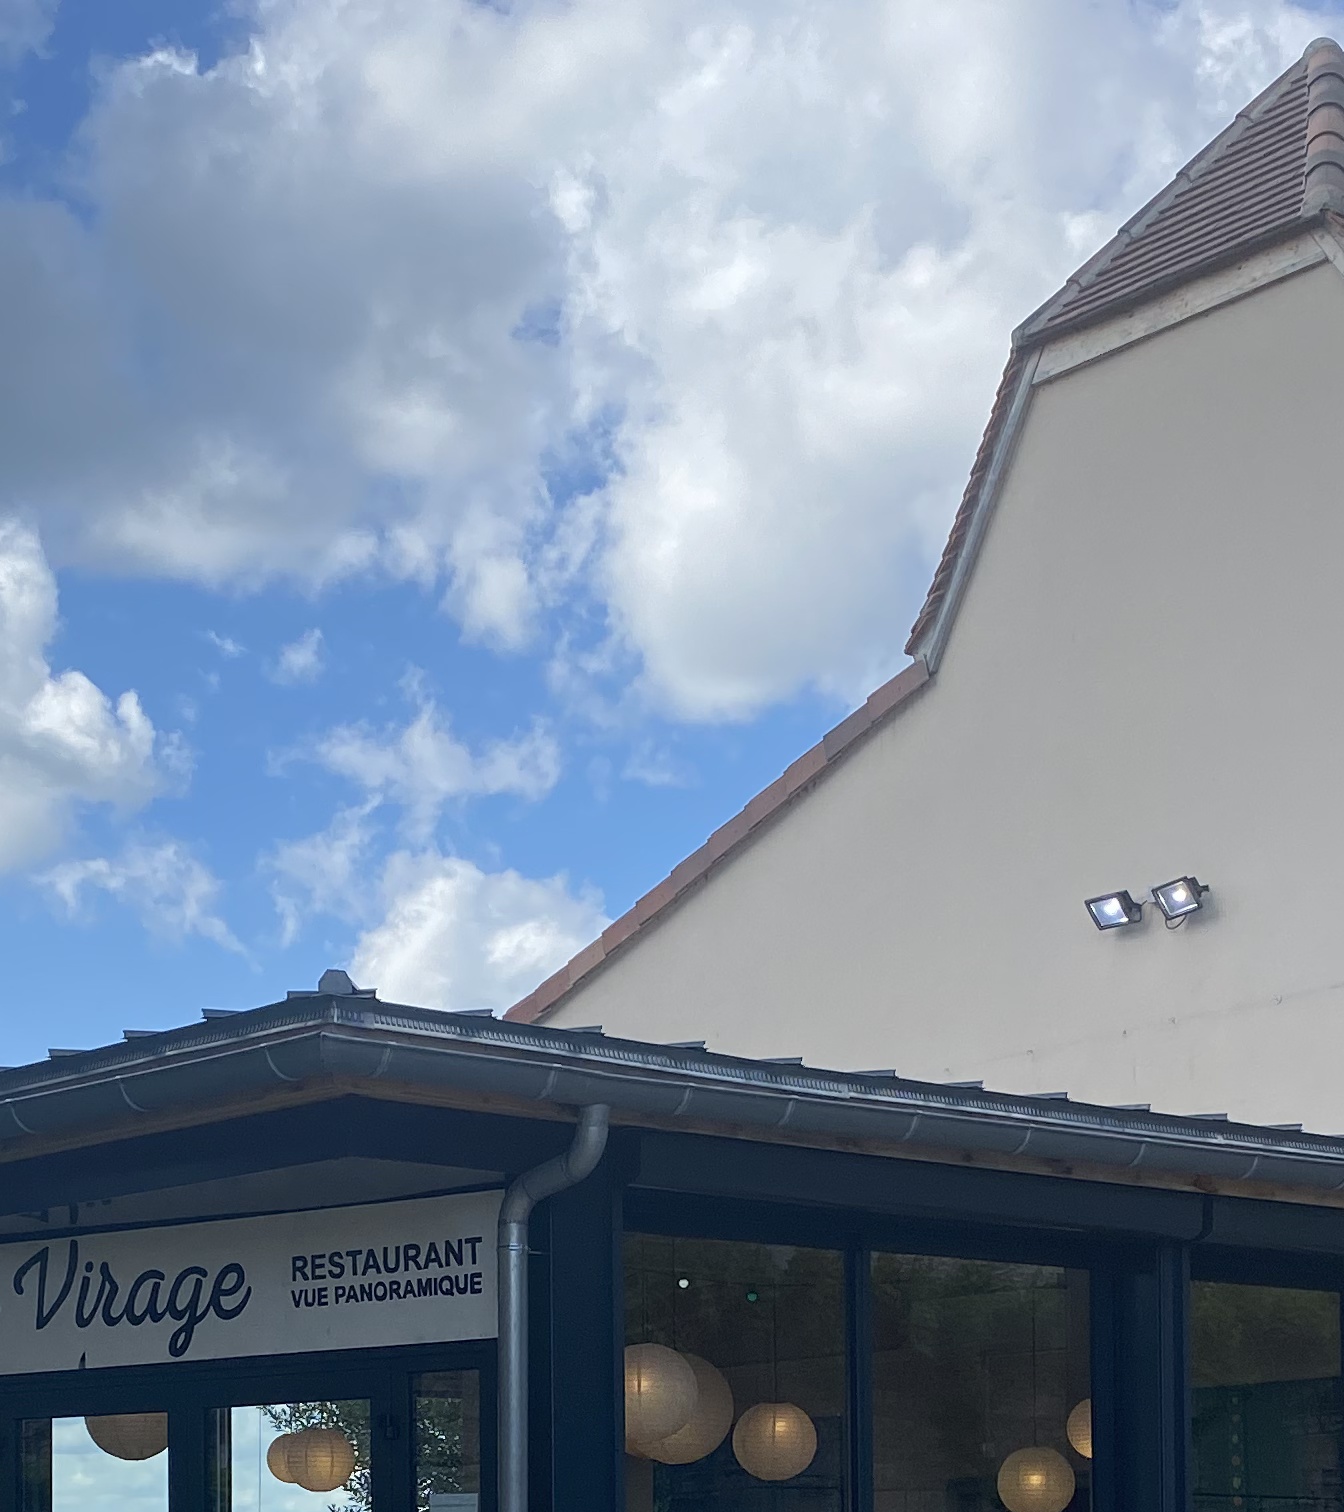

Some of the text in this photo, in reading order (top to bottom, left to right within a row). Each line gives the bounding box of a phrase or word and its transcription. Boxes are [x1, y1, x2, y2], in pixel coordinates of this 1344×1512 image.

[291, 1236, 483, 1282] RESTAURANT
[12, 1239, 252, 1358] Virage
[290, 1272, 483, 1308] VUE PANORAMIQUE
